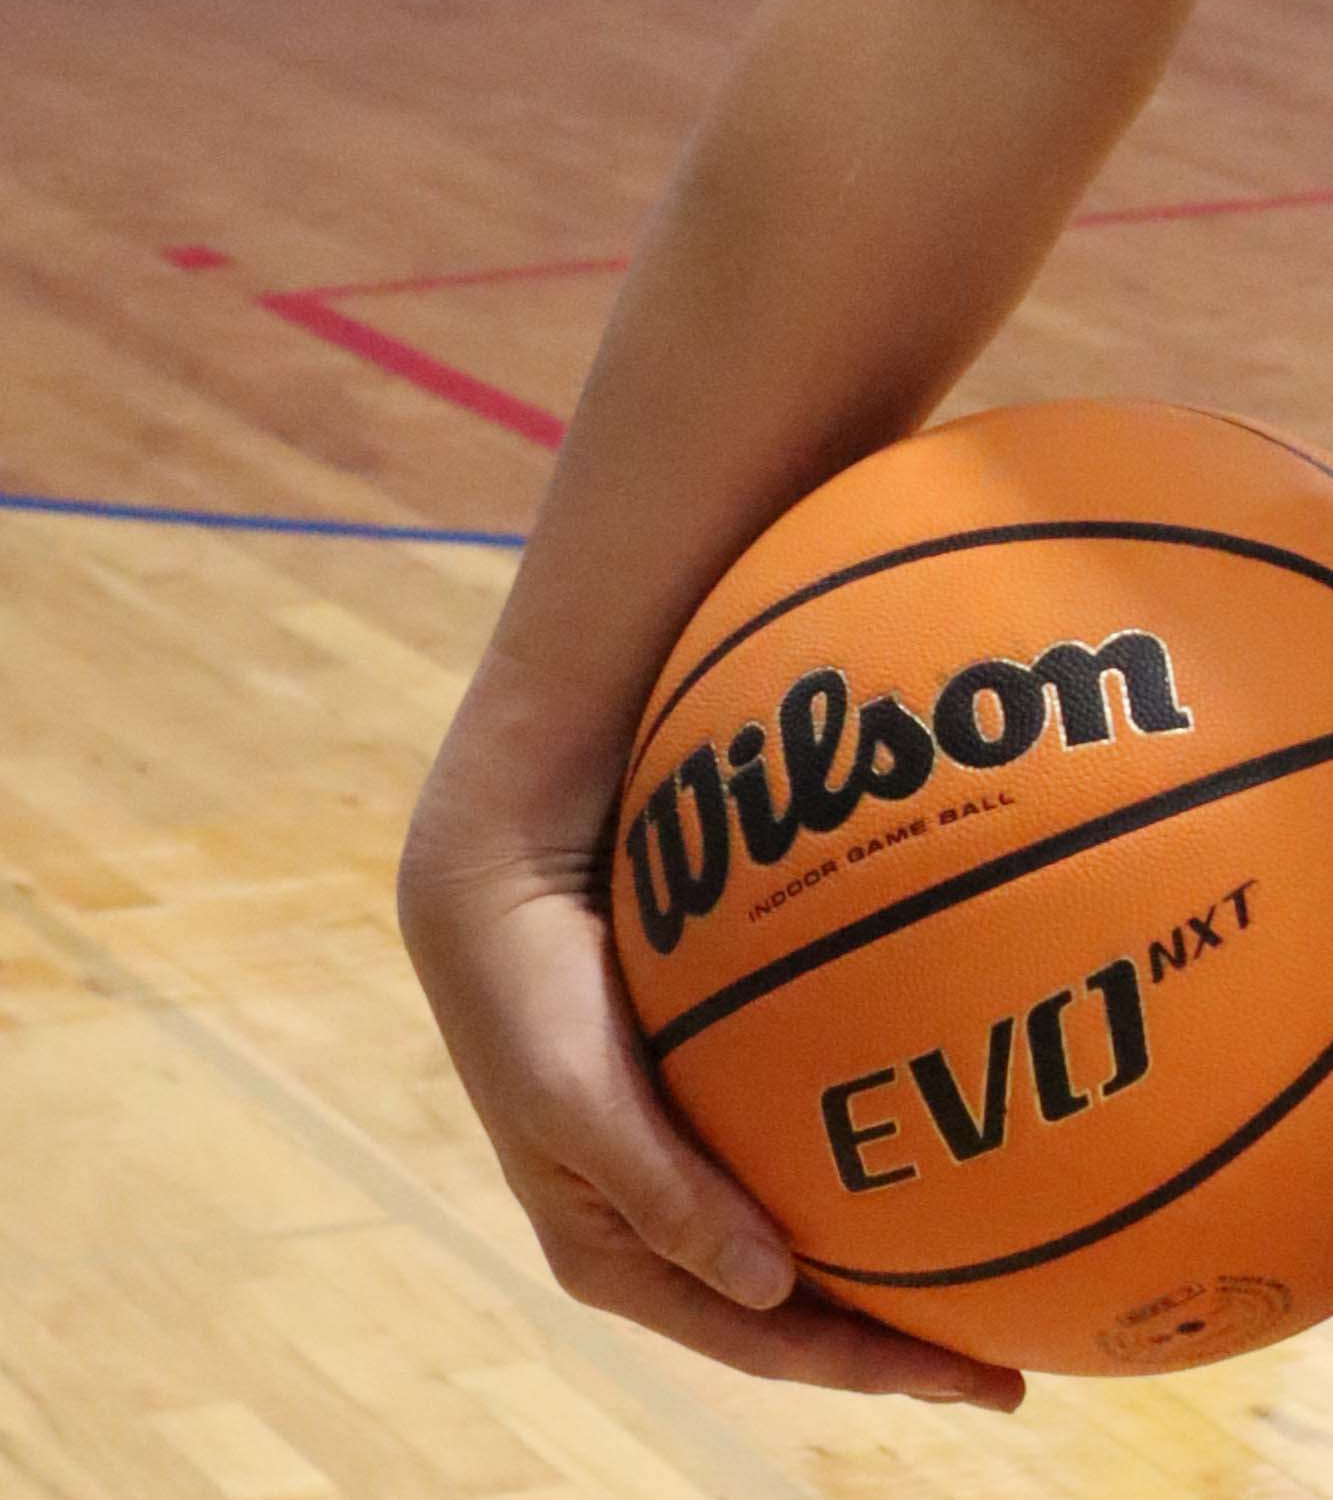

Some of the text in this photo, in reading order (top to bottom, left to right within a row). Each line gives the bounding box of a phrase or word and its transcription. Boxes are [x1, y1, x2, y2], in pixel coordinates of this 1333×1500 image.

[628, 629, 1193, 955] Wilson
[748, 792, 1016, 924] INDOOR GAME BALL
[1150, 879, 1258, 984] NXT
